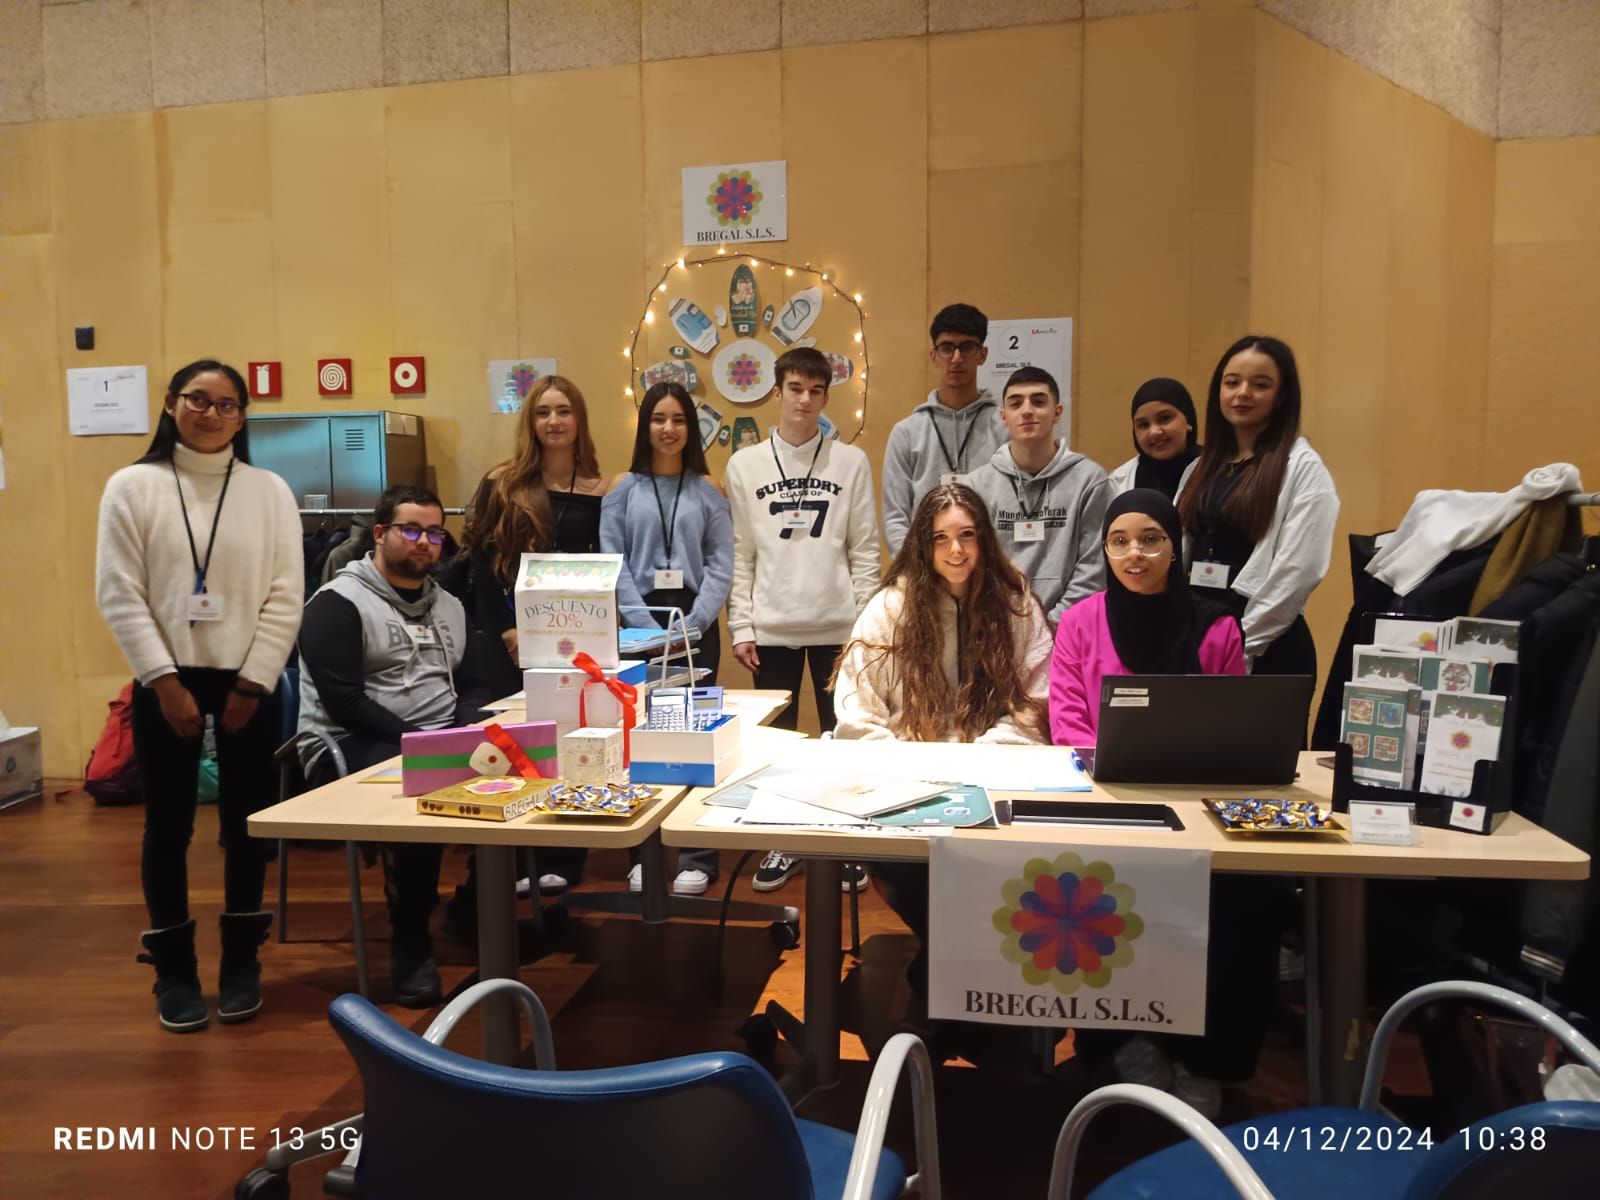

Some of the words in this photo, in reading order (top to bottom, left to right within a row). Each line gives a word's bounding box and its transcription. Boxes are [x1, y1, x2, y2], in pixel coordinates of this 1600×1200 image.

[697, 230, 743, 241] BREGAL
[745, 227, 775, 239] S.L.S.
[1008, 335, 1020, 350] 2
[104, 380, 108, 392] 1
[755, 478, 843, 500] SUPERDRY
[780, 490, 809, 499] CLASS
[524, 600, 608, 620] DESCUENTO
[547, 613, 583, 628] 20%
[964, 990, 1087, 1020] BREGAL
[1094, 997, 1173, 1025] S.L.S.
